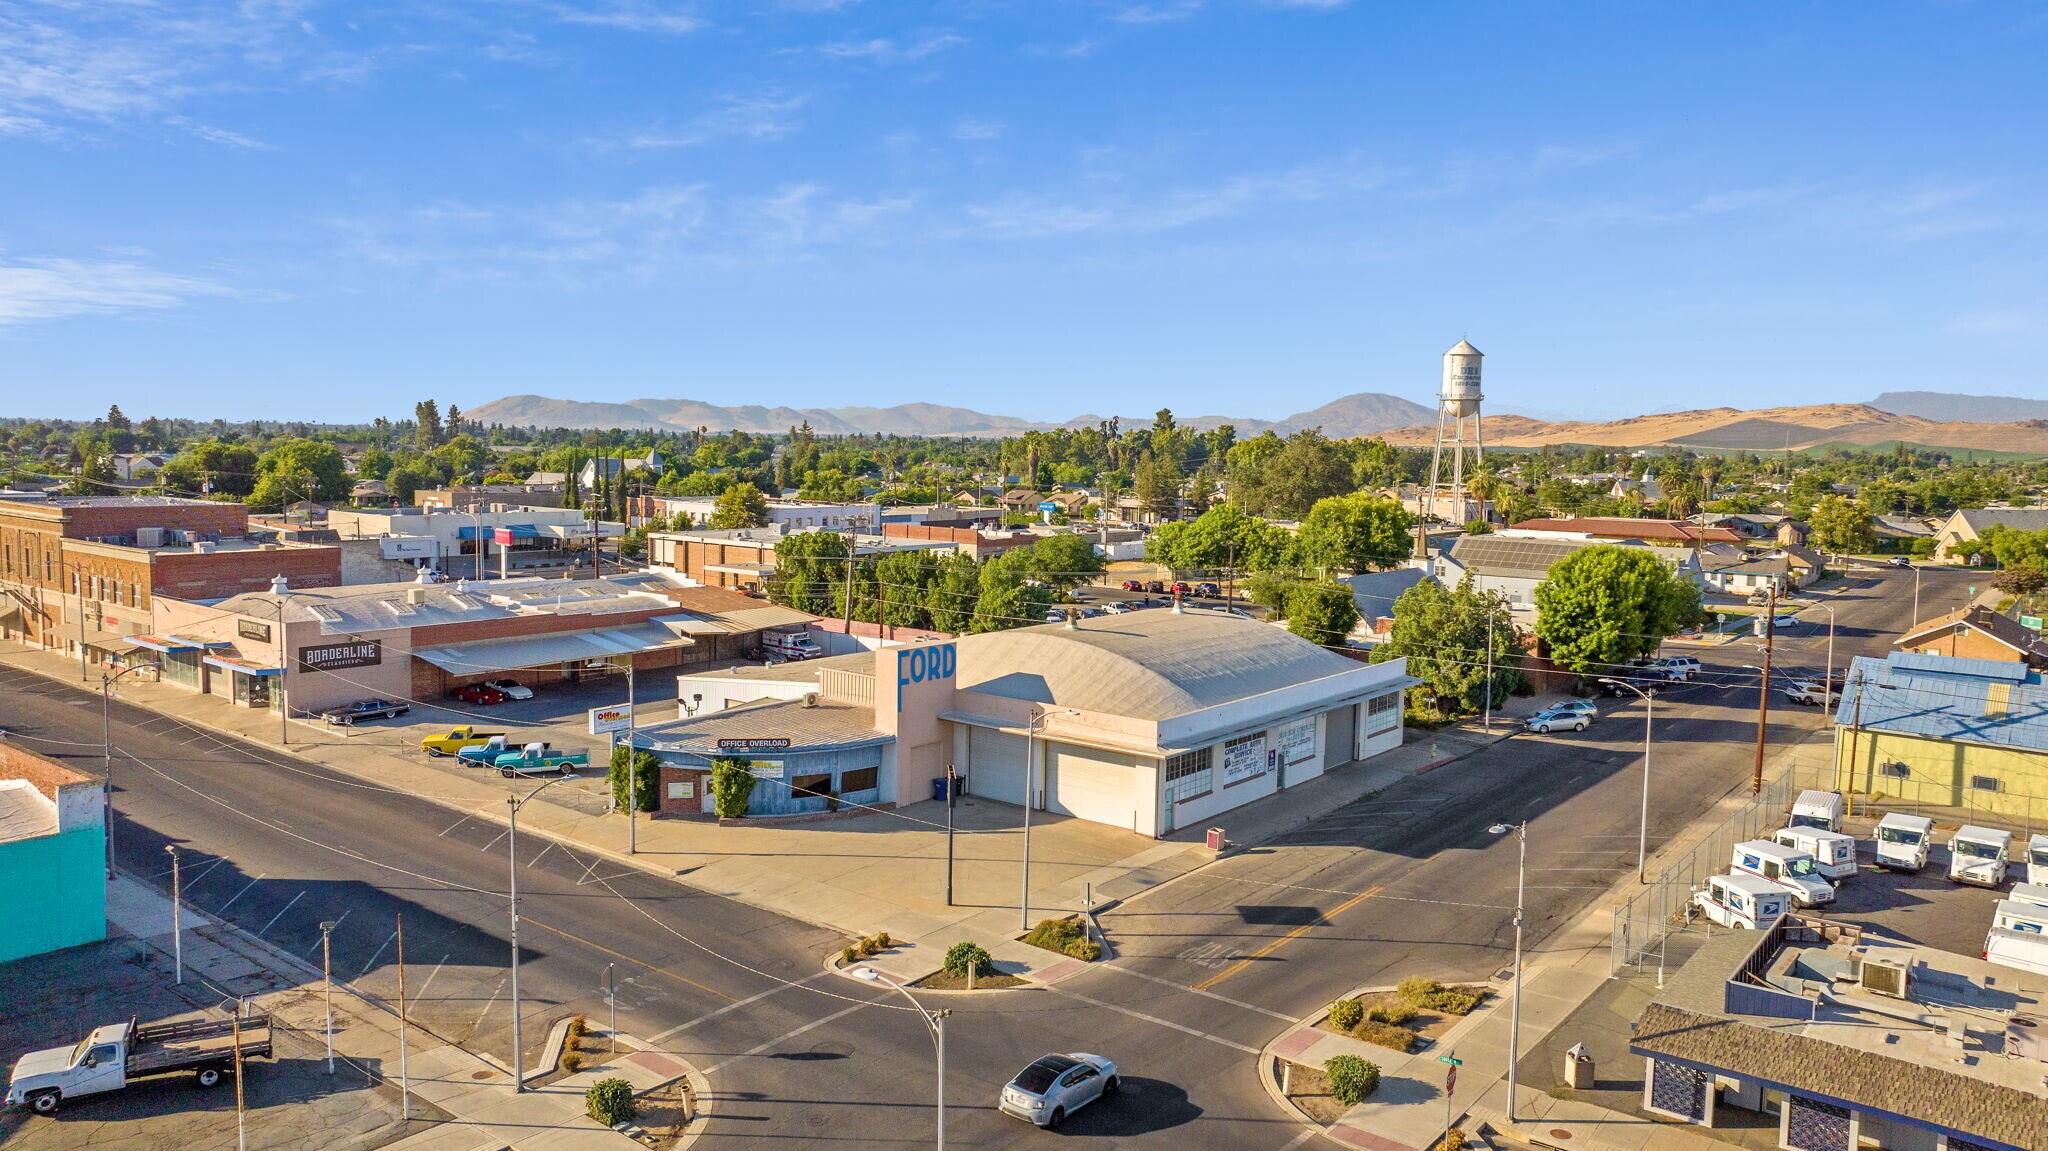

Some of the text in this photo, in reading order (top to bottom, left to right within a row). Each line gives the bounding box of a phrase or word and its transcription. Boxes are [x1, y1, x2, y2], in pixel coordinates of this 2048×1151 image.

[306, 644, 375, 664] BORDERLINE
[898, 644, 957, 712] FORD
[720, 739, 788, 747] OFFICE OVERLOAD
[1224, 743, 1248, 756] COMPLETE
